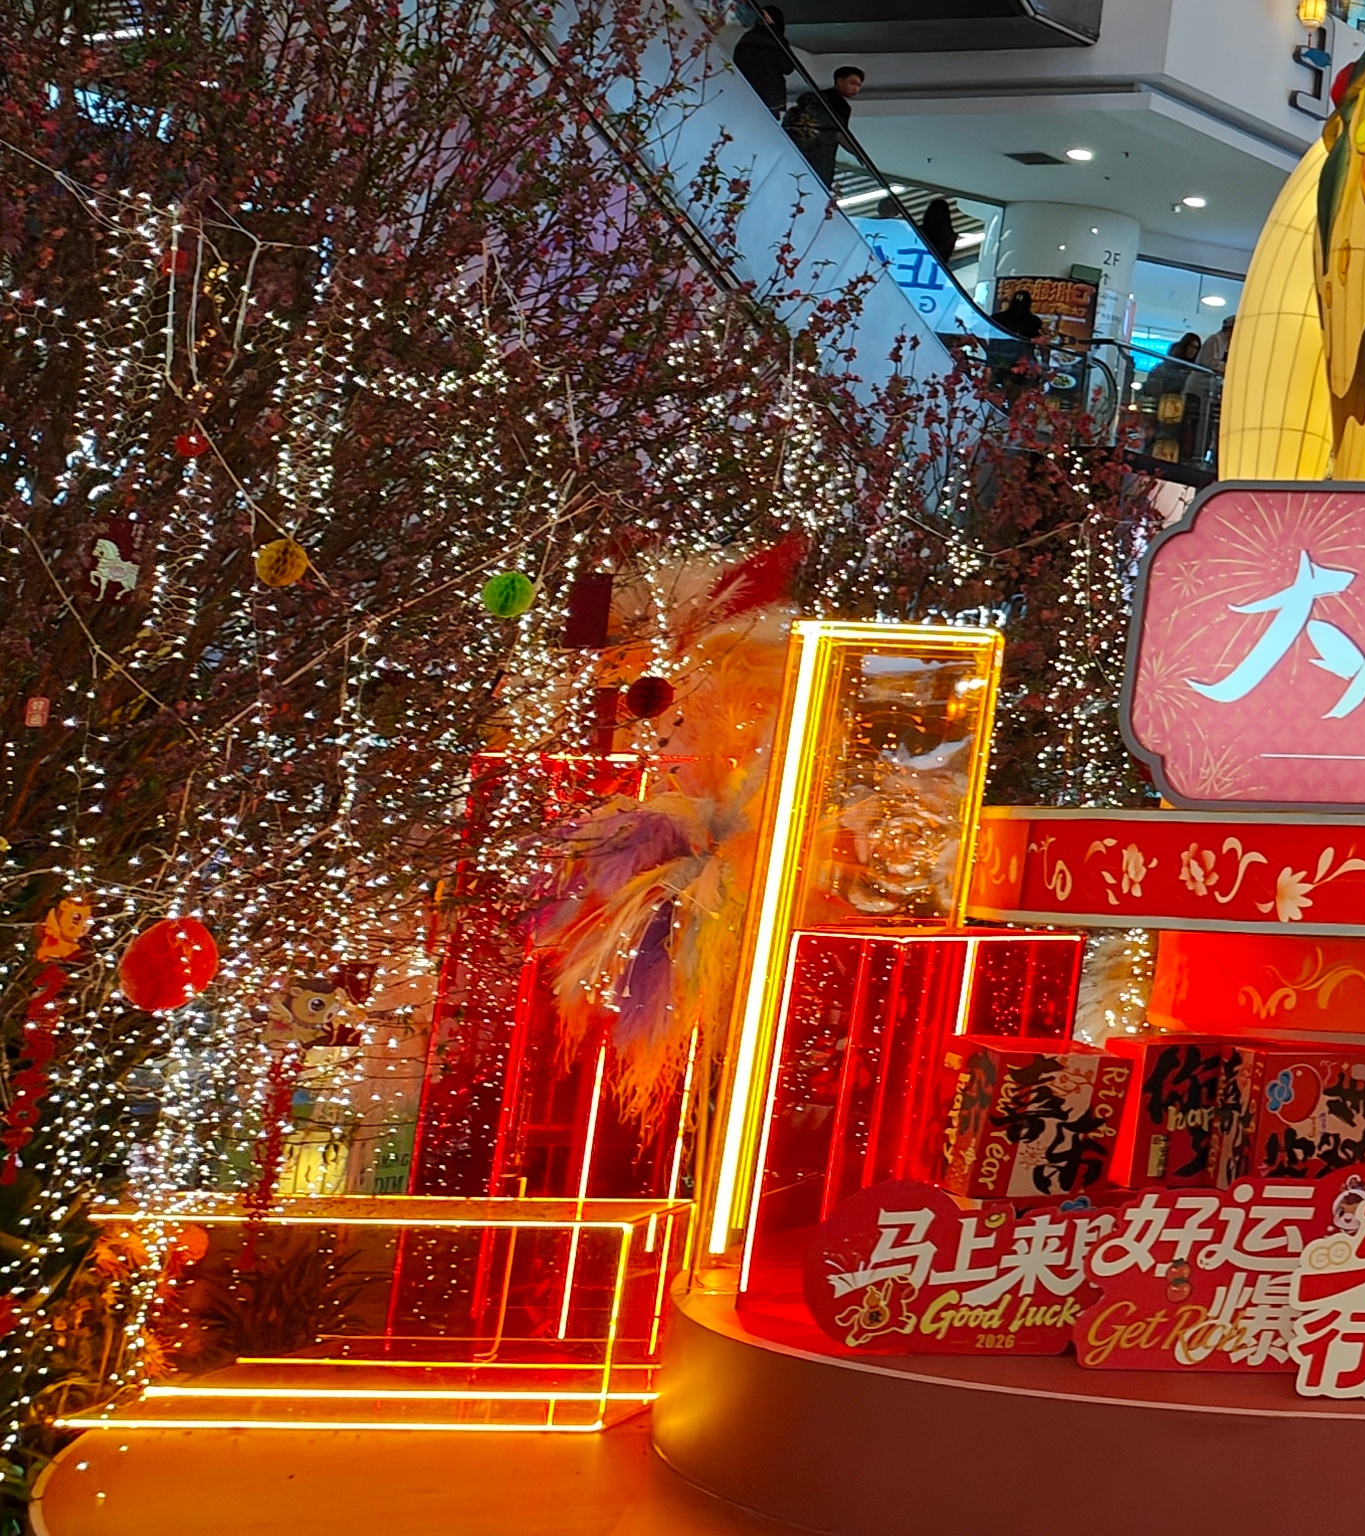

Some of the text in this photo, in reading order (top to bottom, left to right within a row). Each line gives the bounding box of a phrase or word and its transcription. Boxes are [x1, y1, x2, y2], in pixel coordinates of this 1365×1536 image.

[1103, 249, 1122, 267] 2F
[1091, 1183, 1315, 1277] 好运
[920, 1289, 1004, 1340] Good
[1086, 1301, 1250, 1365] Get Rich
[974, 1334, 1016, 1350] 2026
